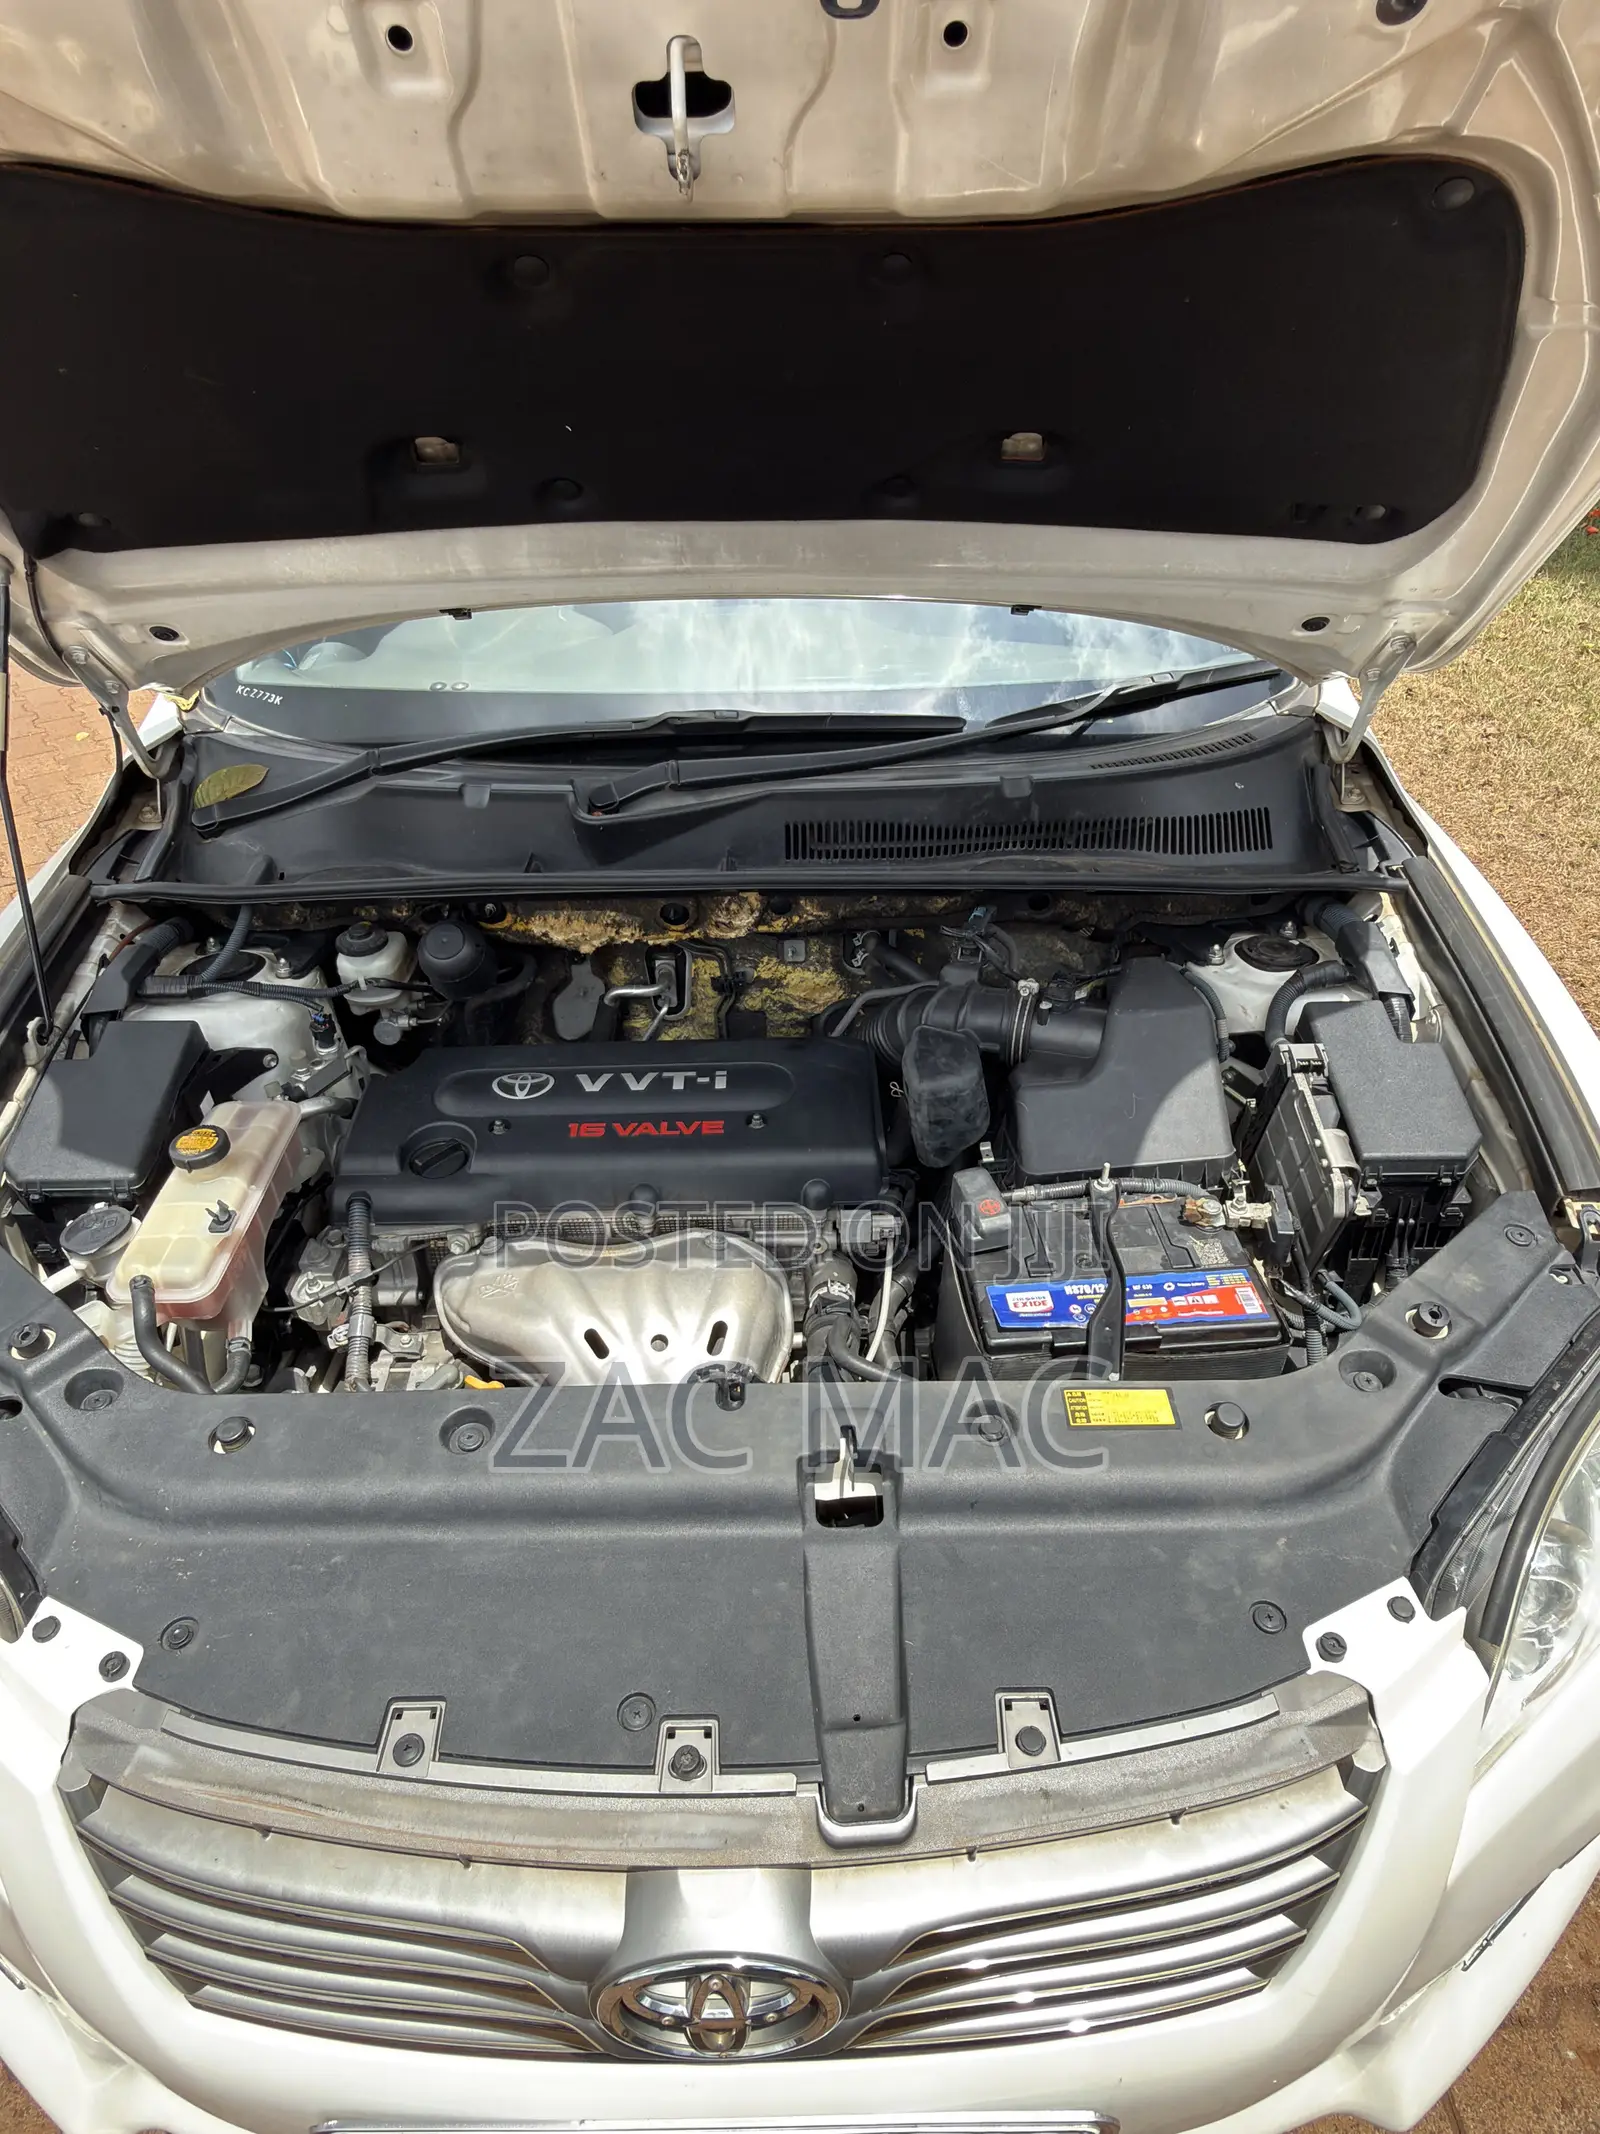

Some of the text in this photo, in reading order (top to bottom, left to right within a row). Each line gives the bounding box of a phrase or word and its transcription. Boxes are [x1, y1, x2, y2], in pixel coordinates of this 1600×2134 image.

[576, 1070, 728, 1092] VVT-i
[568, 1120, 725, 1138] 16 VALVE
[1012, 1300, 1048, 1308] EXIDE
